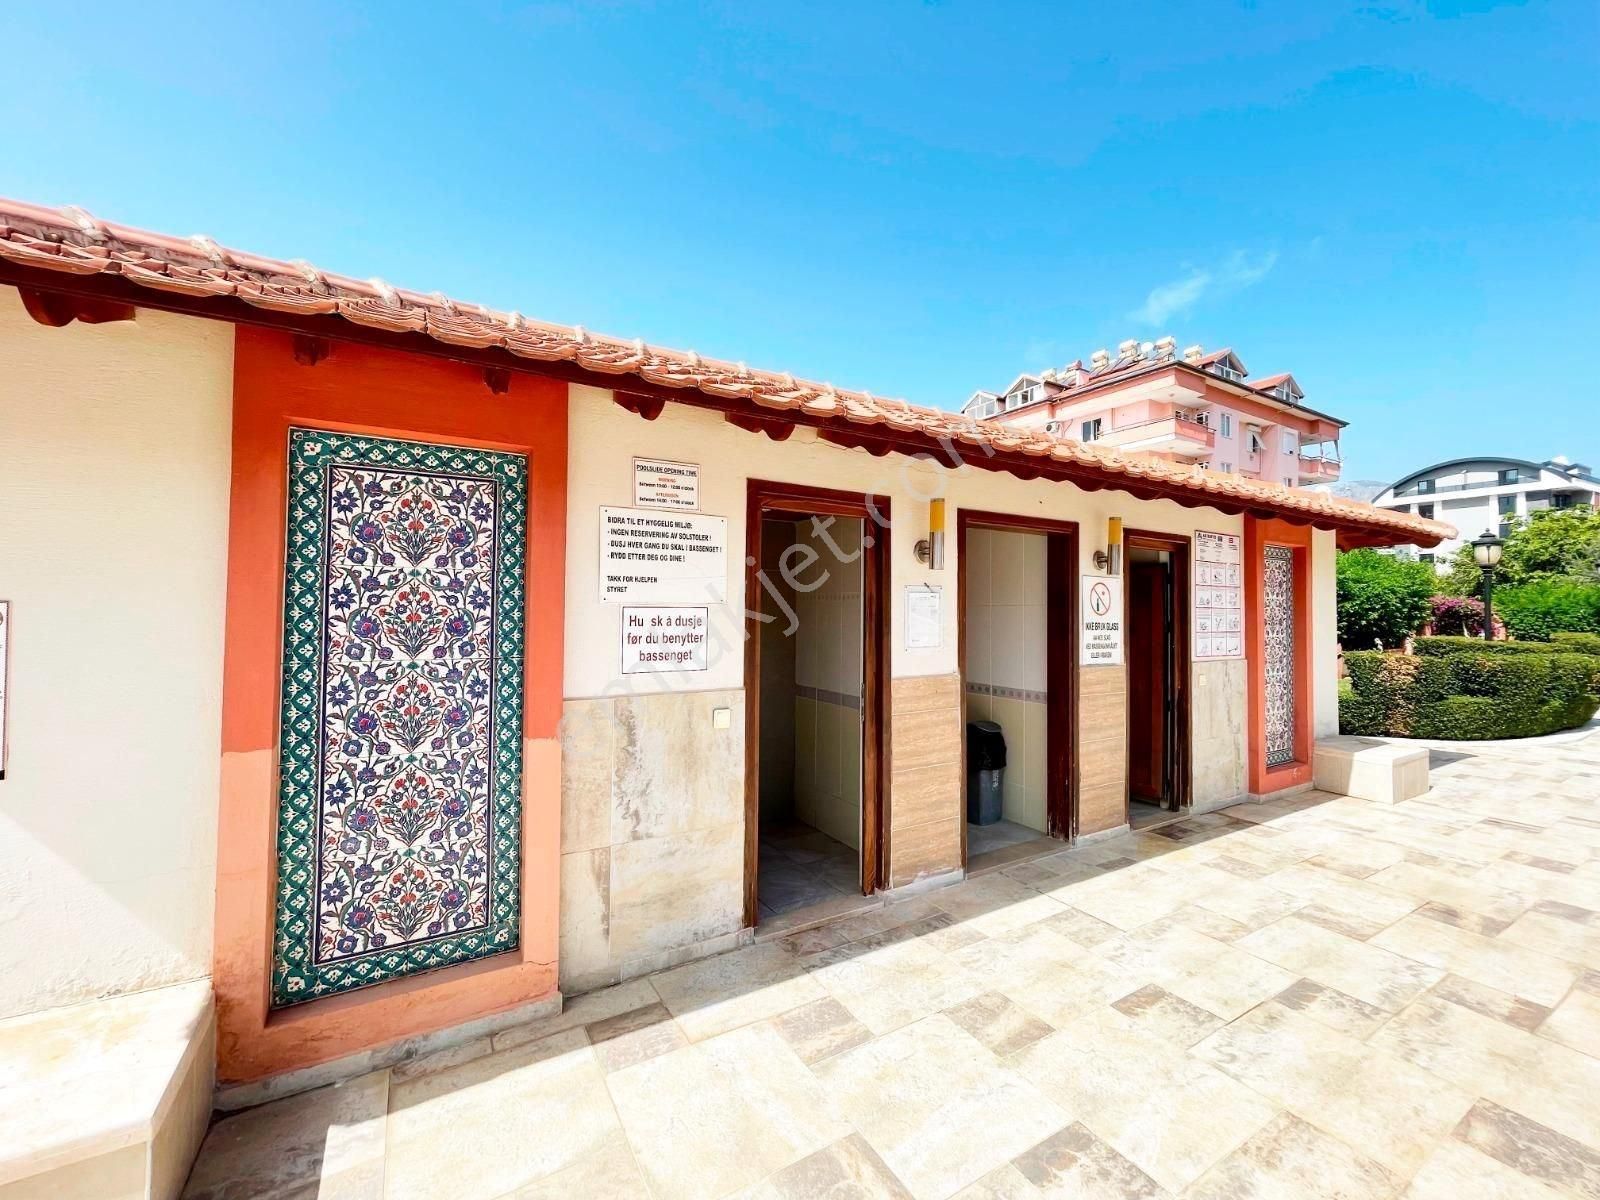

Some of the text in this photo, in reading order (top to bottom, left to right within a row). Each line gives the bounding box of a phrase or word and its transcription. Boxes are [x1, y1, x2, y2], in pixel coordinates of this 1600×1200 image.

[608, 516, 625, 525] BIDRA
[646, 519, 673, 528] HYGGELIG
[631, 530, 669, 538] RESERVERING
[679, 532, 708, 541] SOLSTOLER
[666, 616, 671, 626] å
[675, 616, 702, 629] dusje
[627, 632, 703, 646] før du benytter
[640, 649, 692, 663] bassenget
